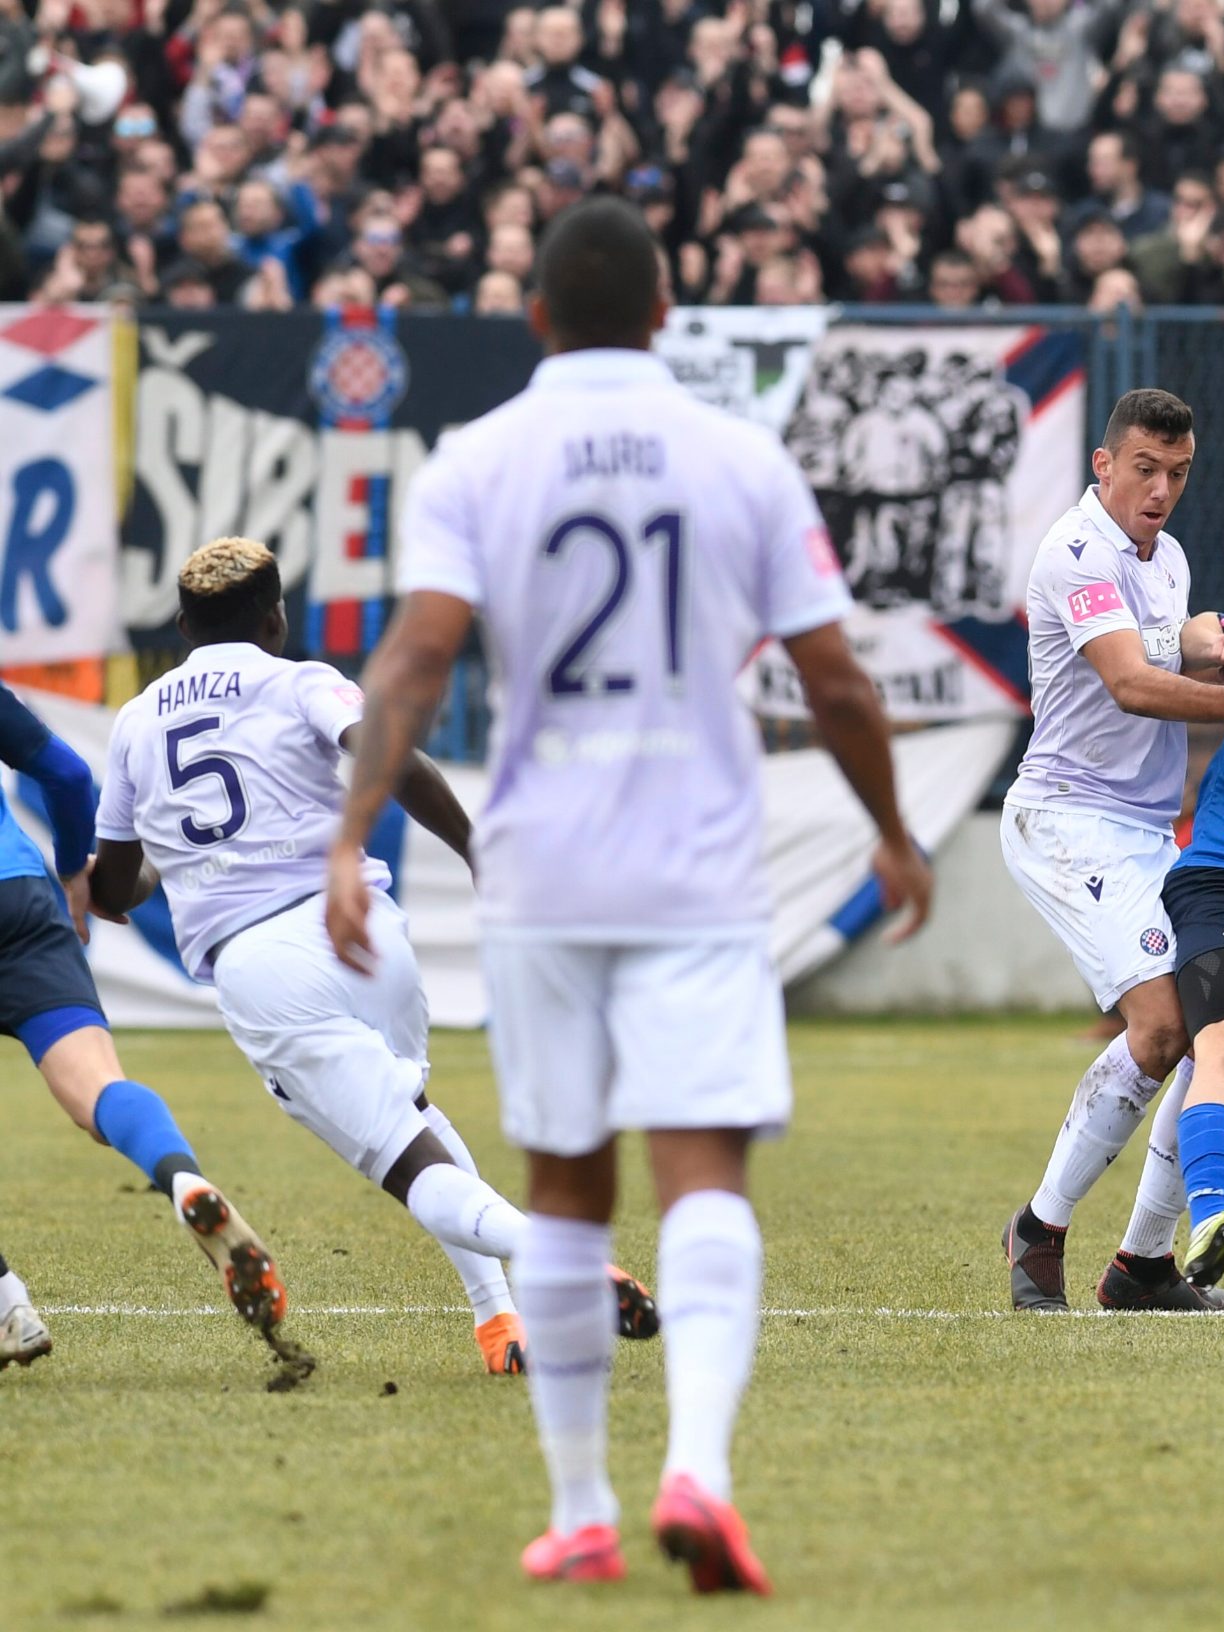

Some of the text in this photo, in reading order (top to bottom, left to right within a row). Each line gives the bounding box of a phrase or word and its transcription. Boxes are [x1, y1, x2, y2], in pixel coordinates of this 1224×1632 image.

[544, 510, 684, 694] 21
[158, 672, 241, 716] HAMZA
[164, 714, 249, 848] 5
